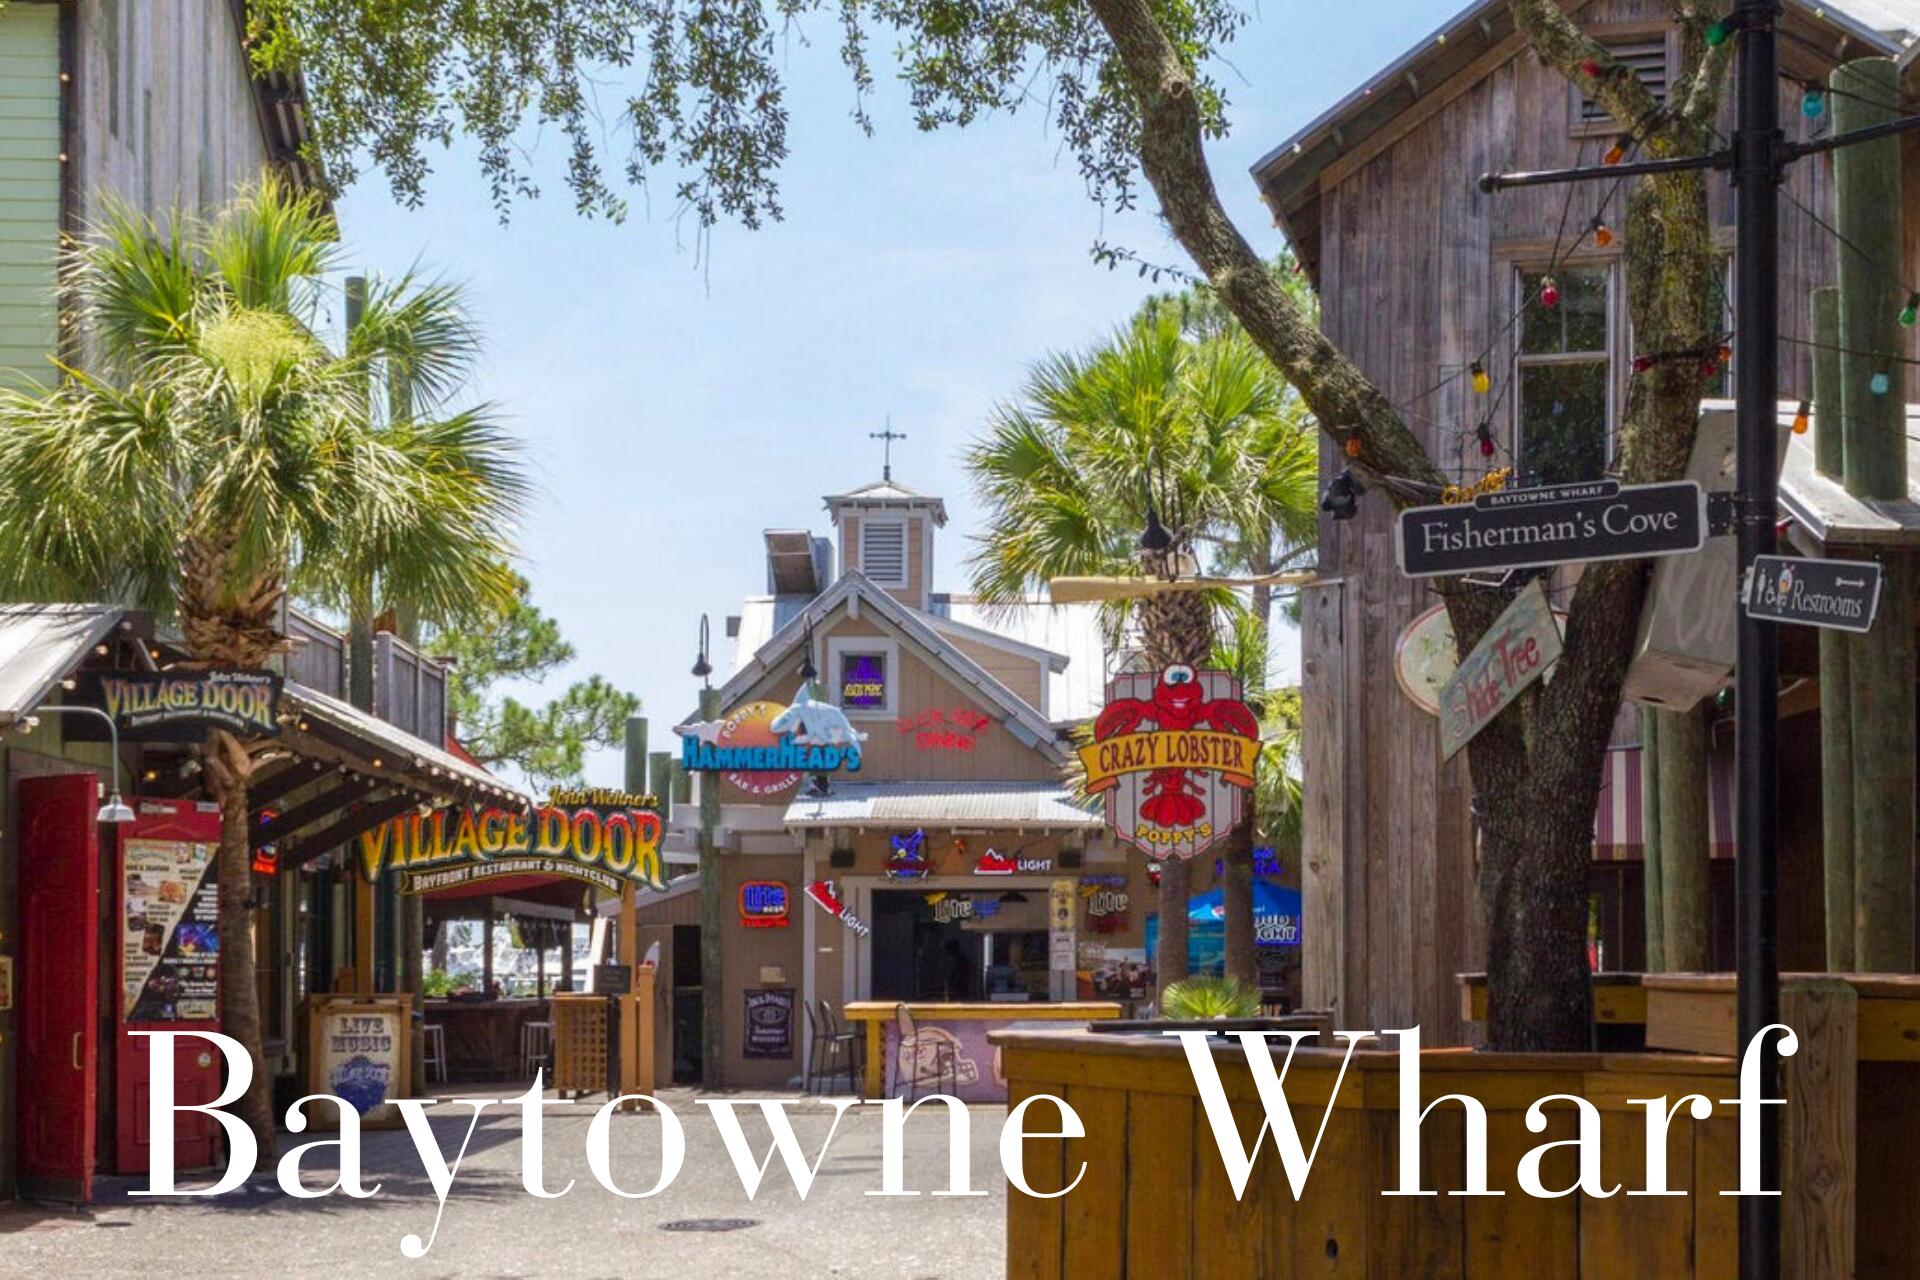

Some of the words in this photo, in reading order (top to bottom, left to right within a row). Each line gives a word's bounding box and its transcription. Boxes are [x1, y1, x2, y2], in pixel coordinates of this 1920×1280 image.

[1490, 490, 1556, 505] BAYTOWNE
[1560, 485, 1605, 498] WHARF
[1421, 511, 1596, 553] Fisherman's
[1602, 504, 1679, 536] Cove
[1791, 579, 1863, 618] Restrooms
[1490, 627, 1541, 690] Tree
[101, 677, 199, 722] VILLAGE
[200, 681, 274, 729] DOOR
[1100, 736, 1159, 772] CRAZY
[1166, 734, 1244, 768] LOBSTER
[358, 806, 530, 882] VILLAGE
[532, 806, 667, 892] DOOR
[1135, 823, 1213, 844] POPPY'S
[413, 868, 470, 891] BAYFRONT
[472, 860, 541, 877] RESTAURANT
[555, 862, 620, 891] NIGHTCLUB
[1017, 859, 1053, 872] LIGHT
[838, 907, 870, 938] LIGHT
[339, 1017, 385, 1034] LIVE
[330, 1035, 392, 1053] MUSIC
